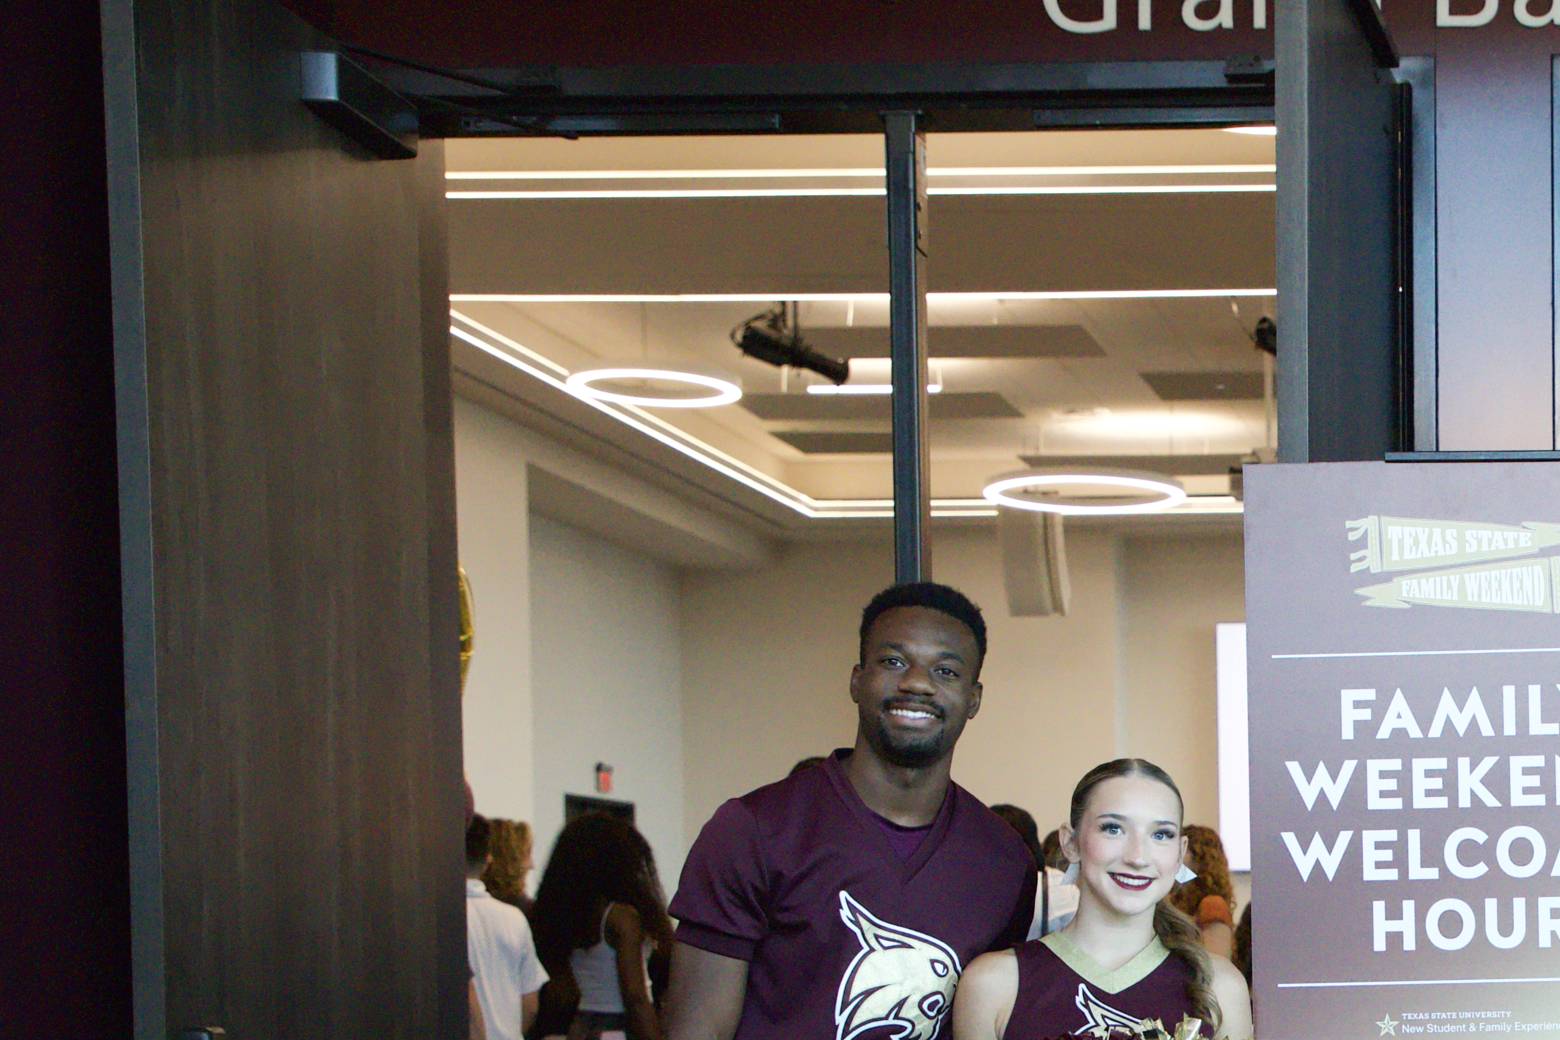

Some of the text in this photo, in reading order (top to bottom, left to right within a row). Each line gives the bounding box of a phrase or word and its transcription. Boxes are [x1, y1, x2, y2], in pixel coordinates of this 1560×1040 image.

[1387, 525, 1532, 562] TEXAS STATE
[1400, 564, 1546, 607] FAMILY WEEKEND
[1401, 1010, 1512, 1021] TEXAS STATE UNIVERSITY
[1402, 1024, 1425, 1034] New
[1426, 1022, 1466, 1034] Student
[1468, 1022, 1476, 1033] &
[1479, 1021, 1512, 1035] Family
